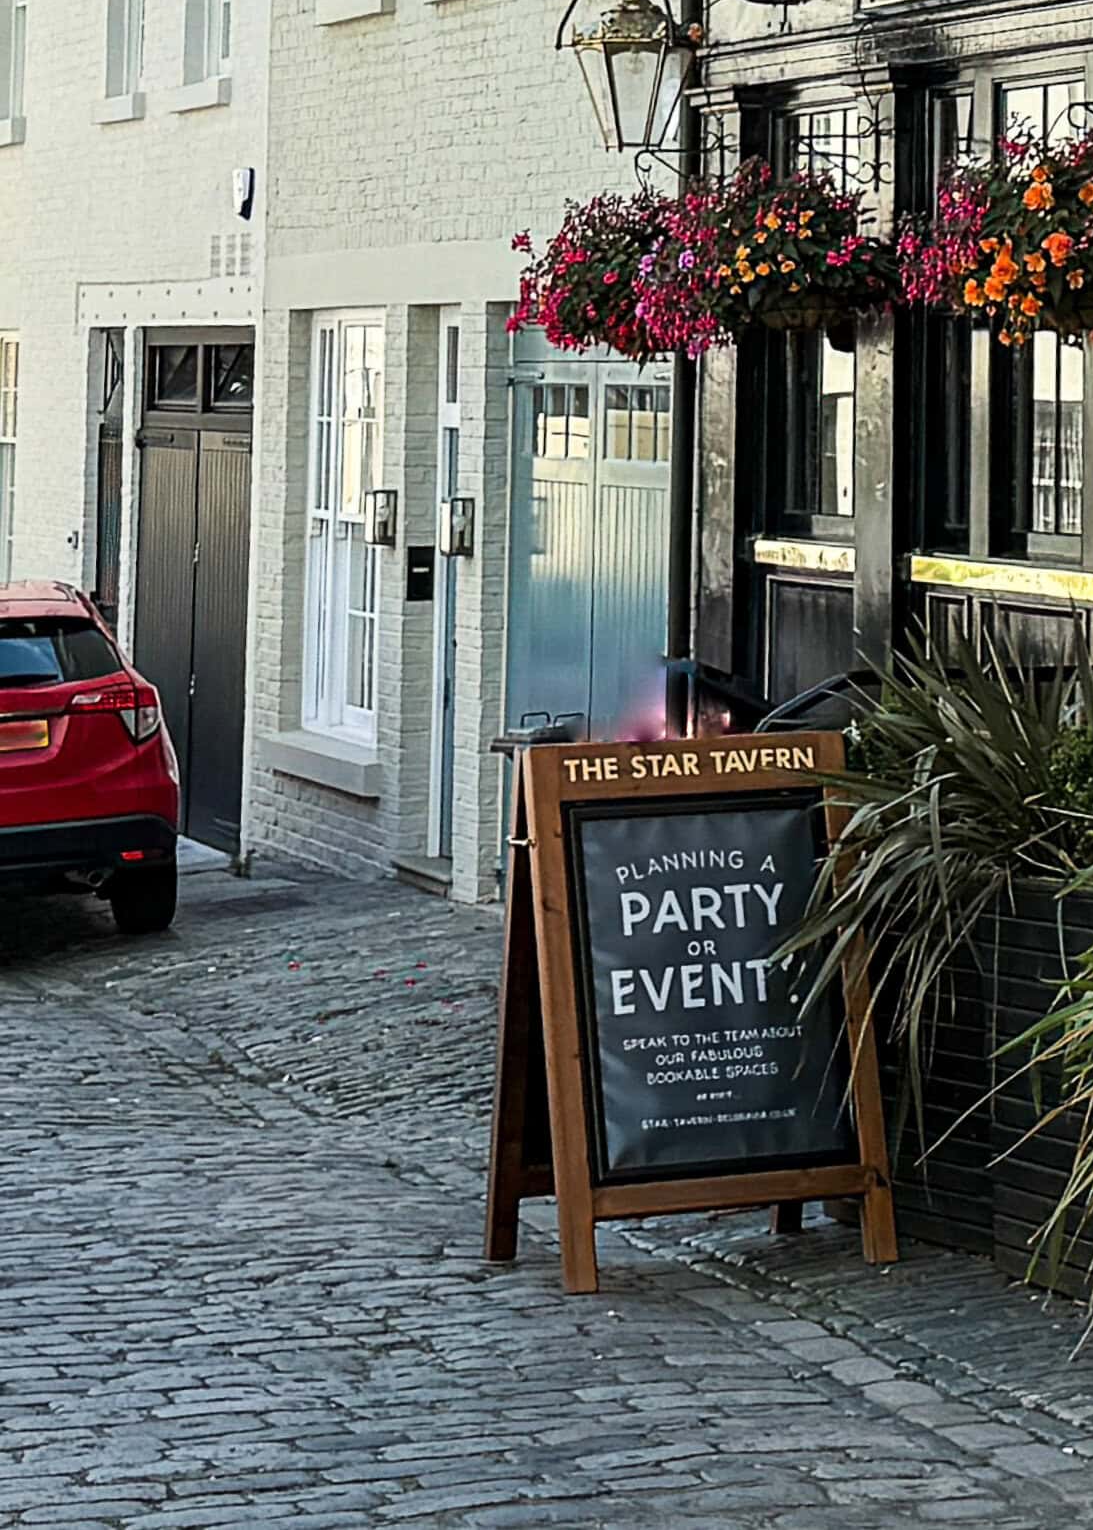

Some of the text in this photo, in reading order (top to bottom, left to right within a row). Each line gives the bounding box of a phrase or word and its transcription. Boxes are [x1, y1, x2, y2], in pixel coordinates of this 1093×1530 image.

[563, 746, 815, 783] THE STAR TAVERN
[615, 850, 776, 885] PLANNING A
[620, 882, 784, 936] PARTY
[687, 939, 717, 956] OR
[622, 1036, 668, 1051] SPEAK
[672, 1034, 690, 1047] TO
[695, 1031, 720, 1045] THE
[724, 1027, 759, 1043] TEAM
[655, 1045, 764, 1066] OUR FABULOUS
[646, 1062, 779, 1085] BOOKABLE SPACES
